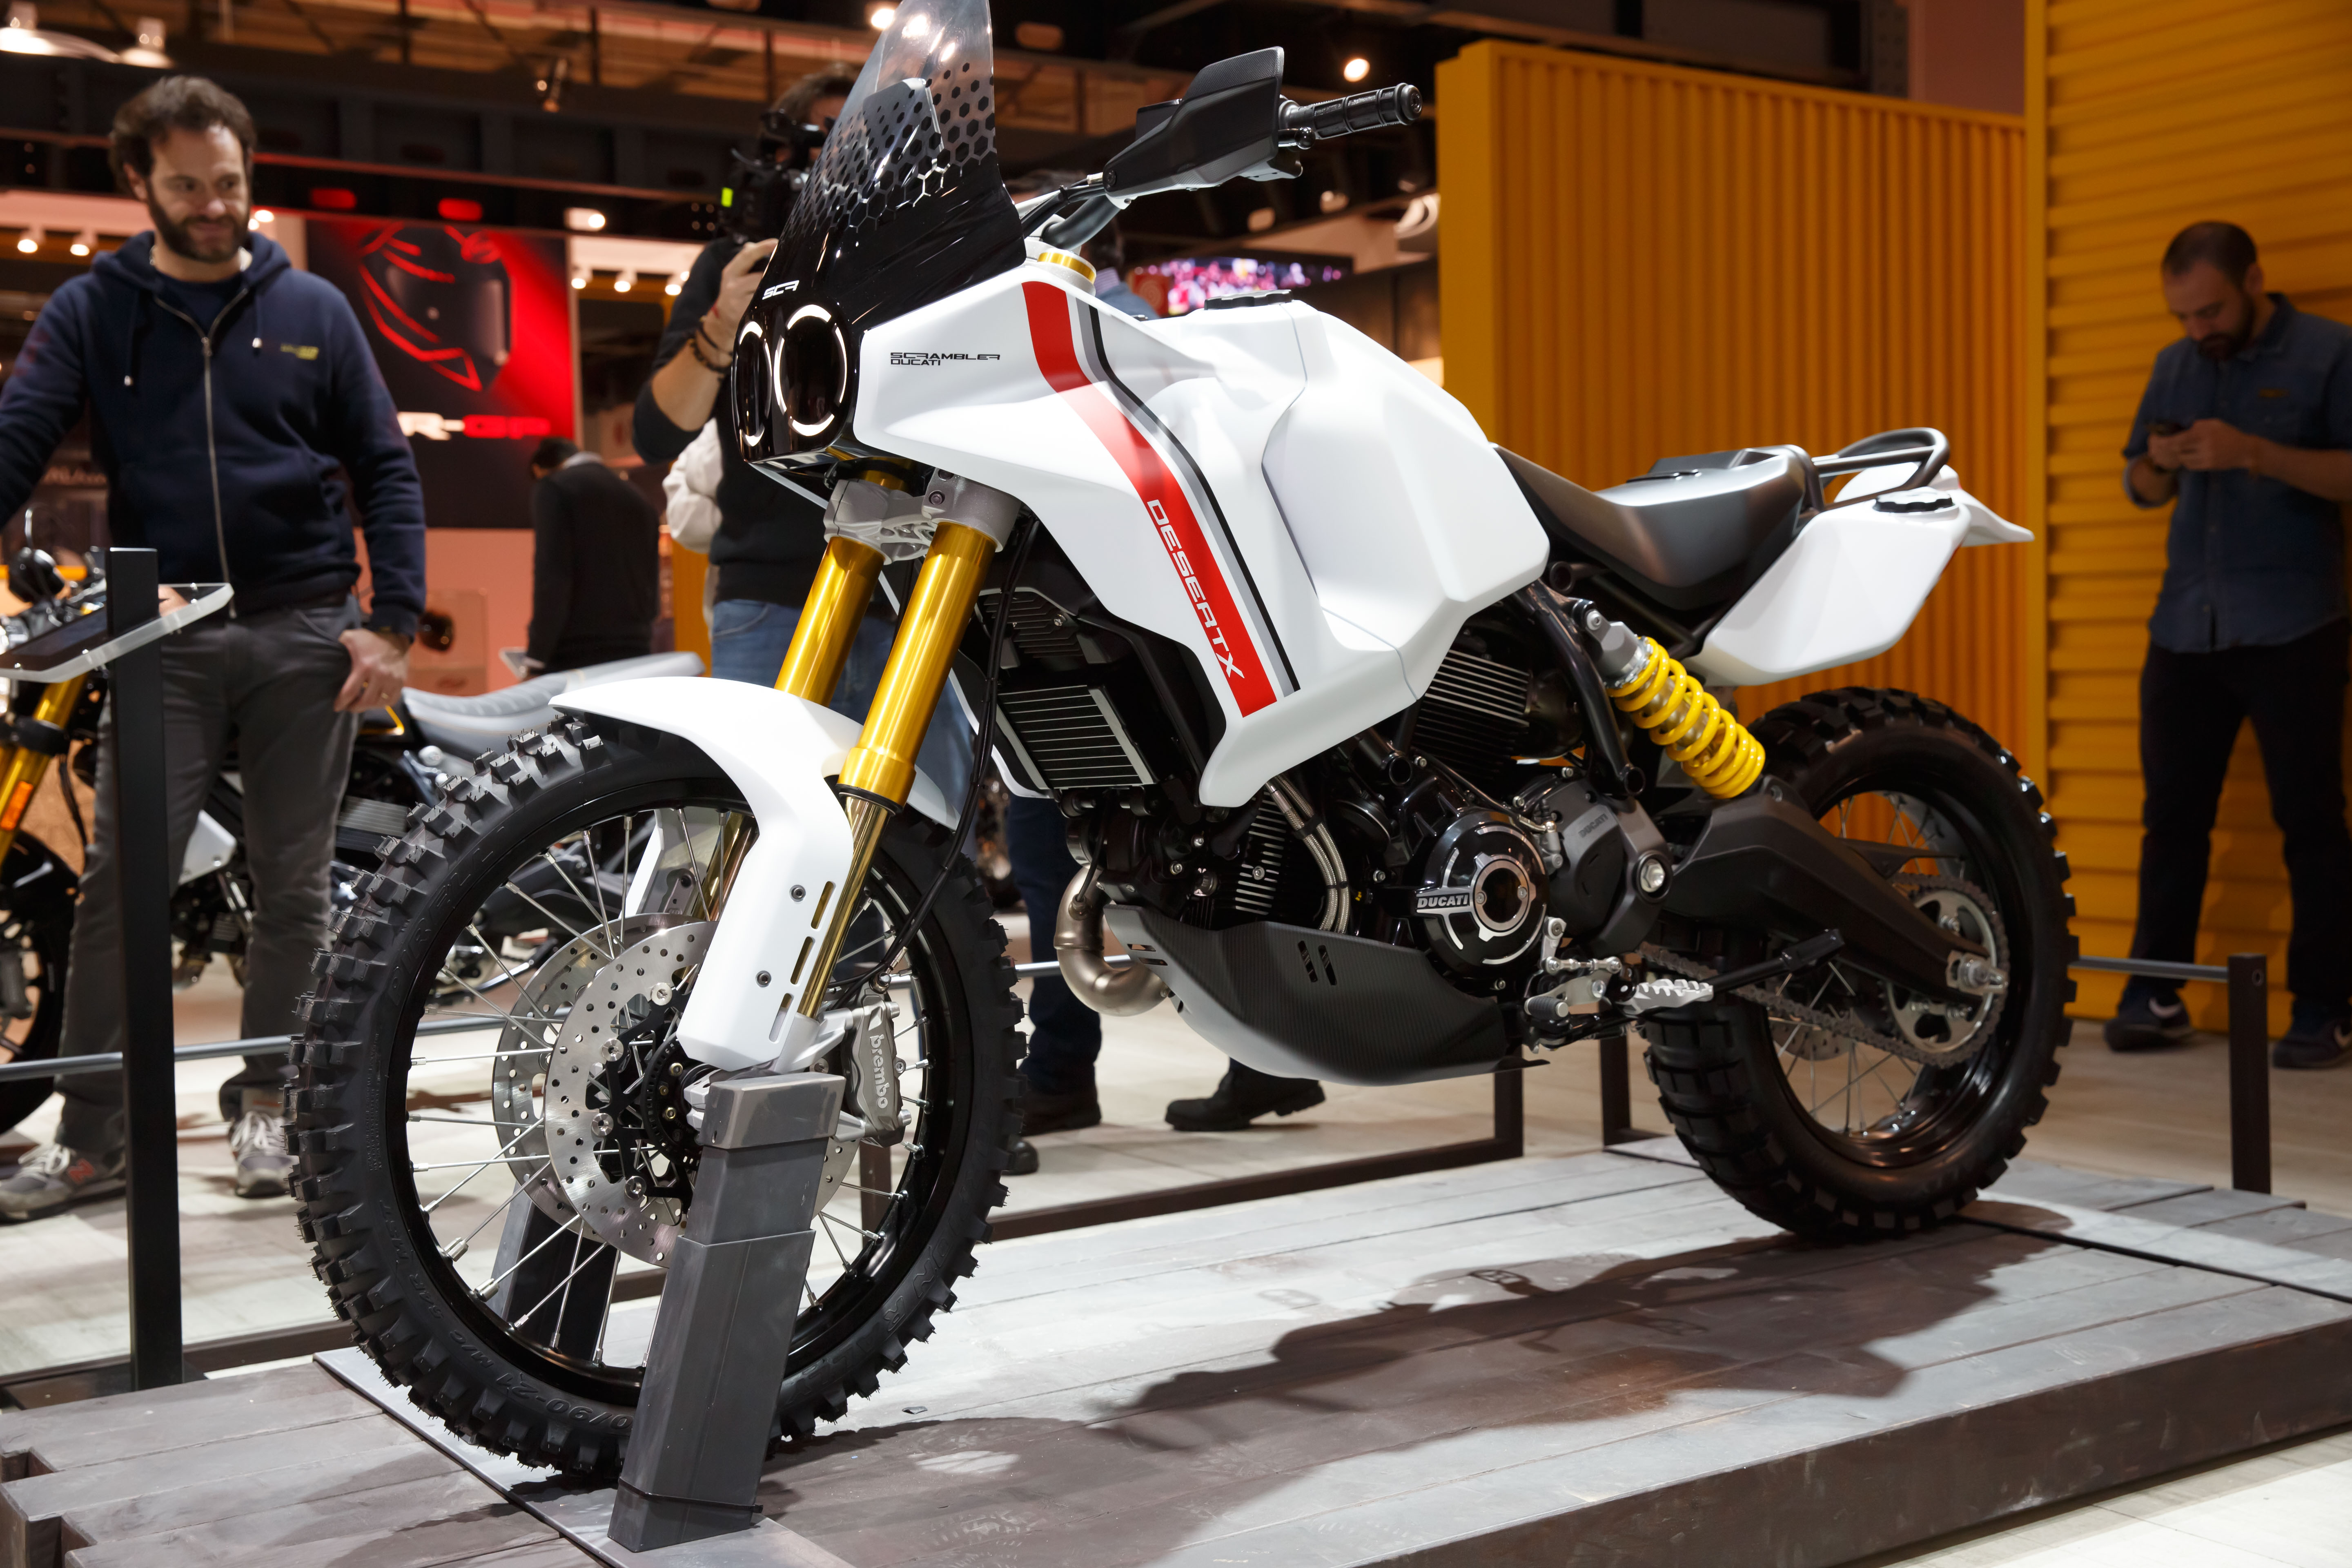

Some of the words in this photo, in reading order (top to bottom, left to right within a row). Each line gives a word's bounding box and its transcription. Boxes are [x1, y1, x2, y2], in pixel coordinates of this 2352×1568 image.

[762, 280, 800, 300] SCR
[890, 352, 1000, 361] SCRAMBLER
[1147, 499, 1245, 679] DESERTX
[1578, 813, 1609, 838] DUCATI
[1417, 894, 1468, 909] DUCATI
[869, 1034, 890, 1109] brembo
[495, 1372, 635, 1429] 0/90-21
